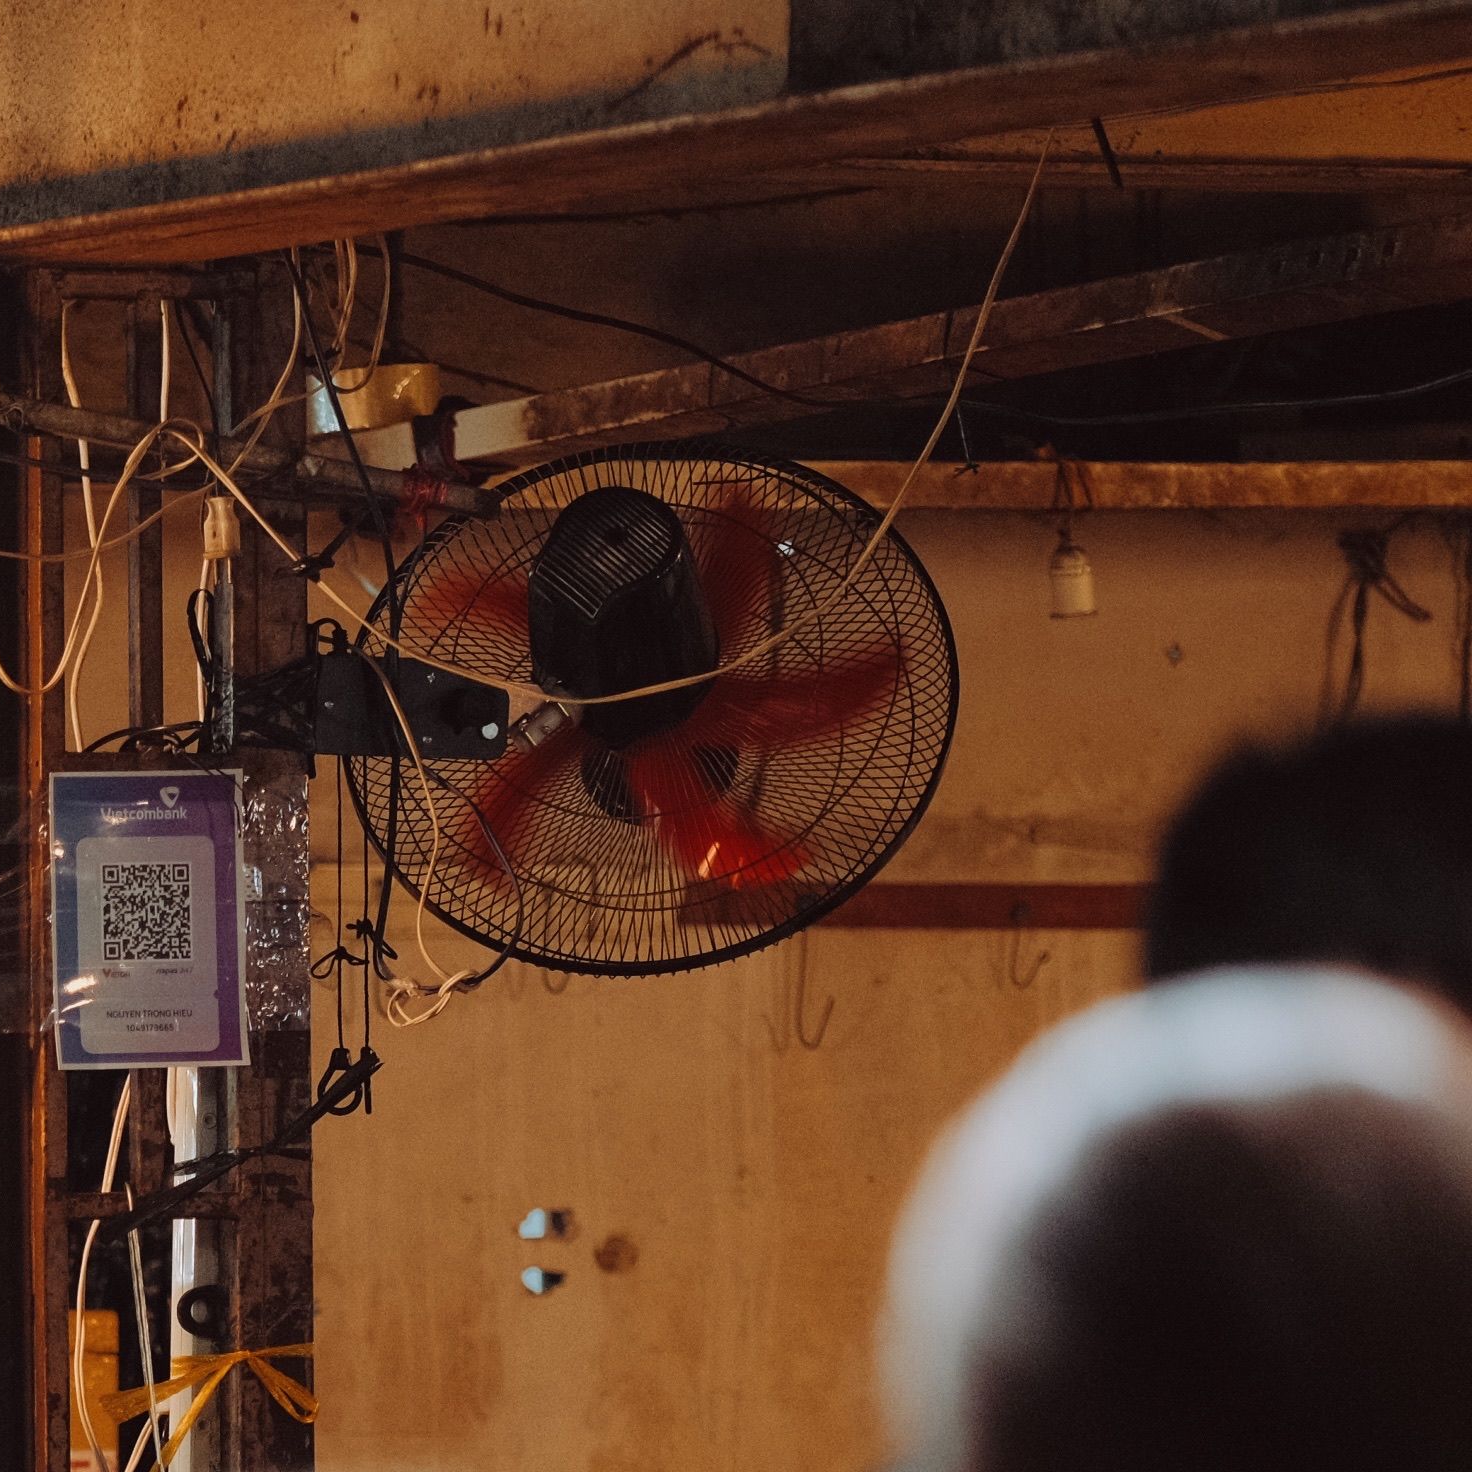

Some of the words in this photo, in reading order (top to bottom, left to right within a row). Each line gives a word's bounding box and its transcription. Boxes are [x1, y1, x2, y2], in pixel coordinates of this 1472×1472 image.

[100, 806, 187, 820] Vietcombank
[106, 1009, 141, 1018] NGUYEN
[143, 1009, 171, 1018] TRONG
[173, 1009, 193, 1018] HIEU
